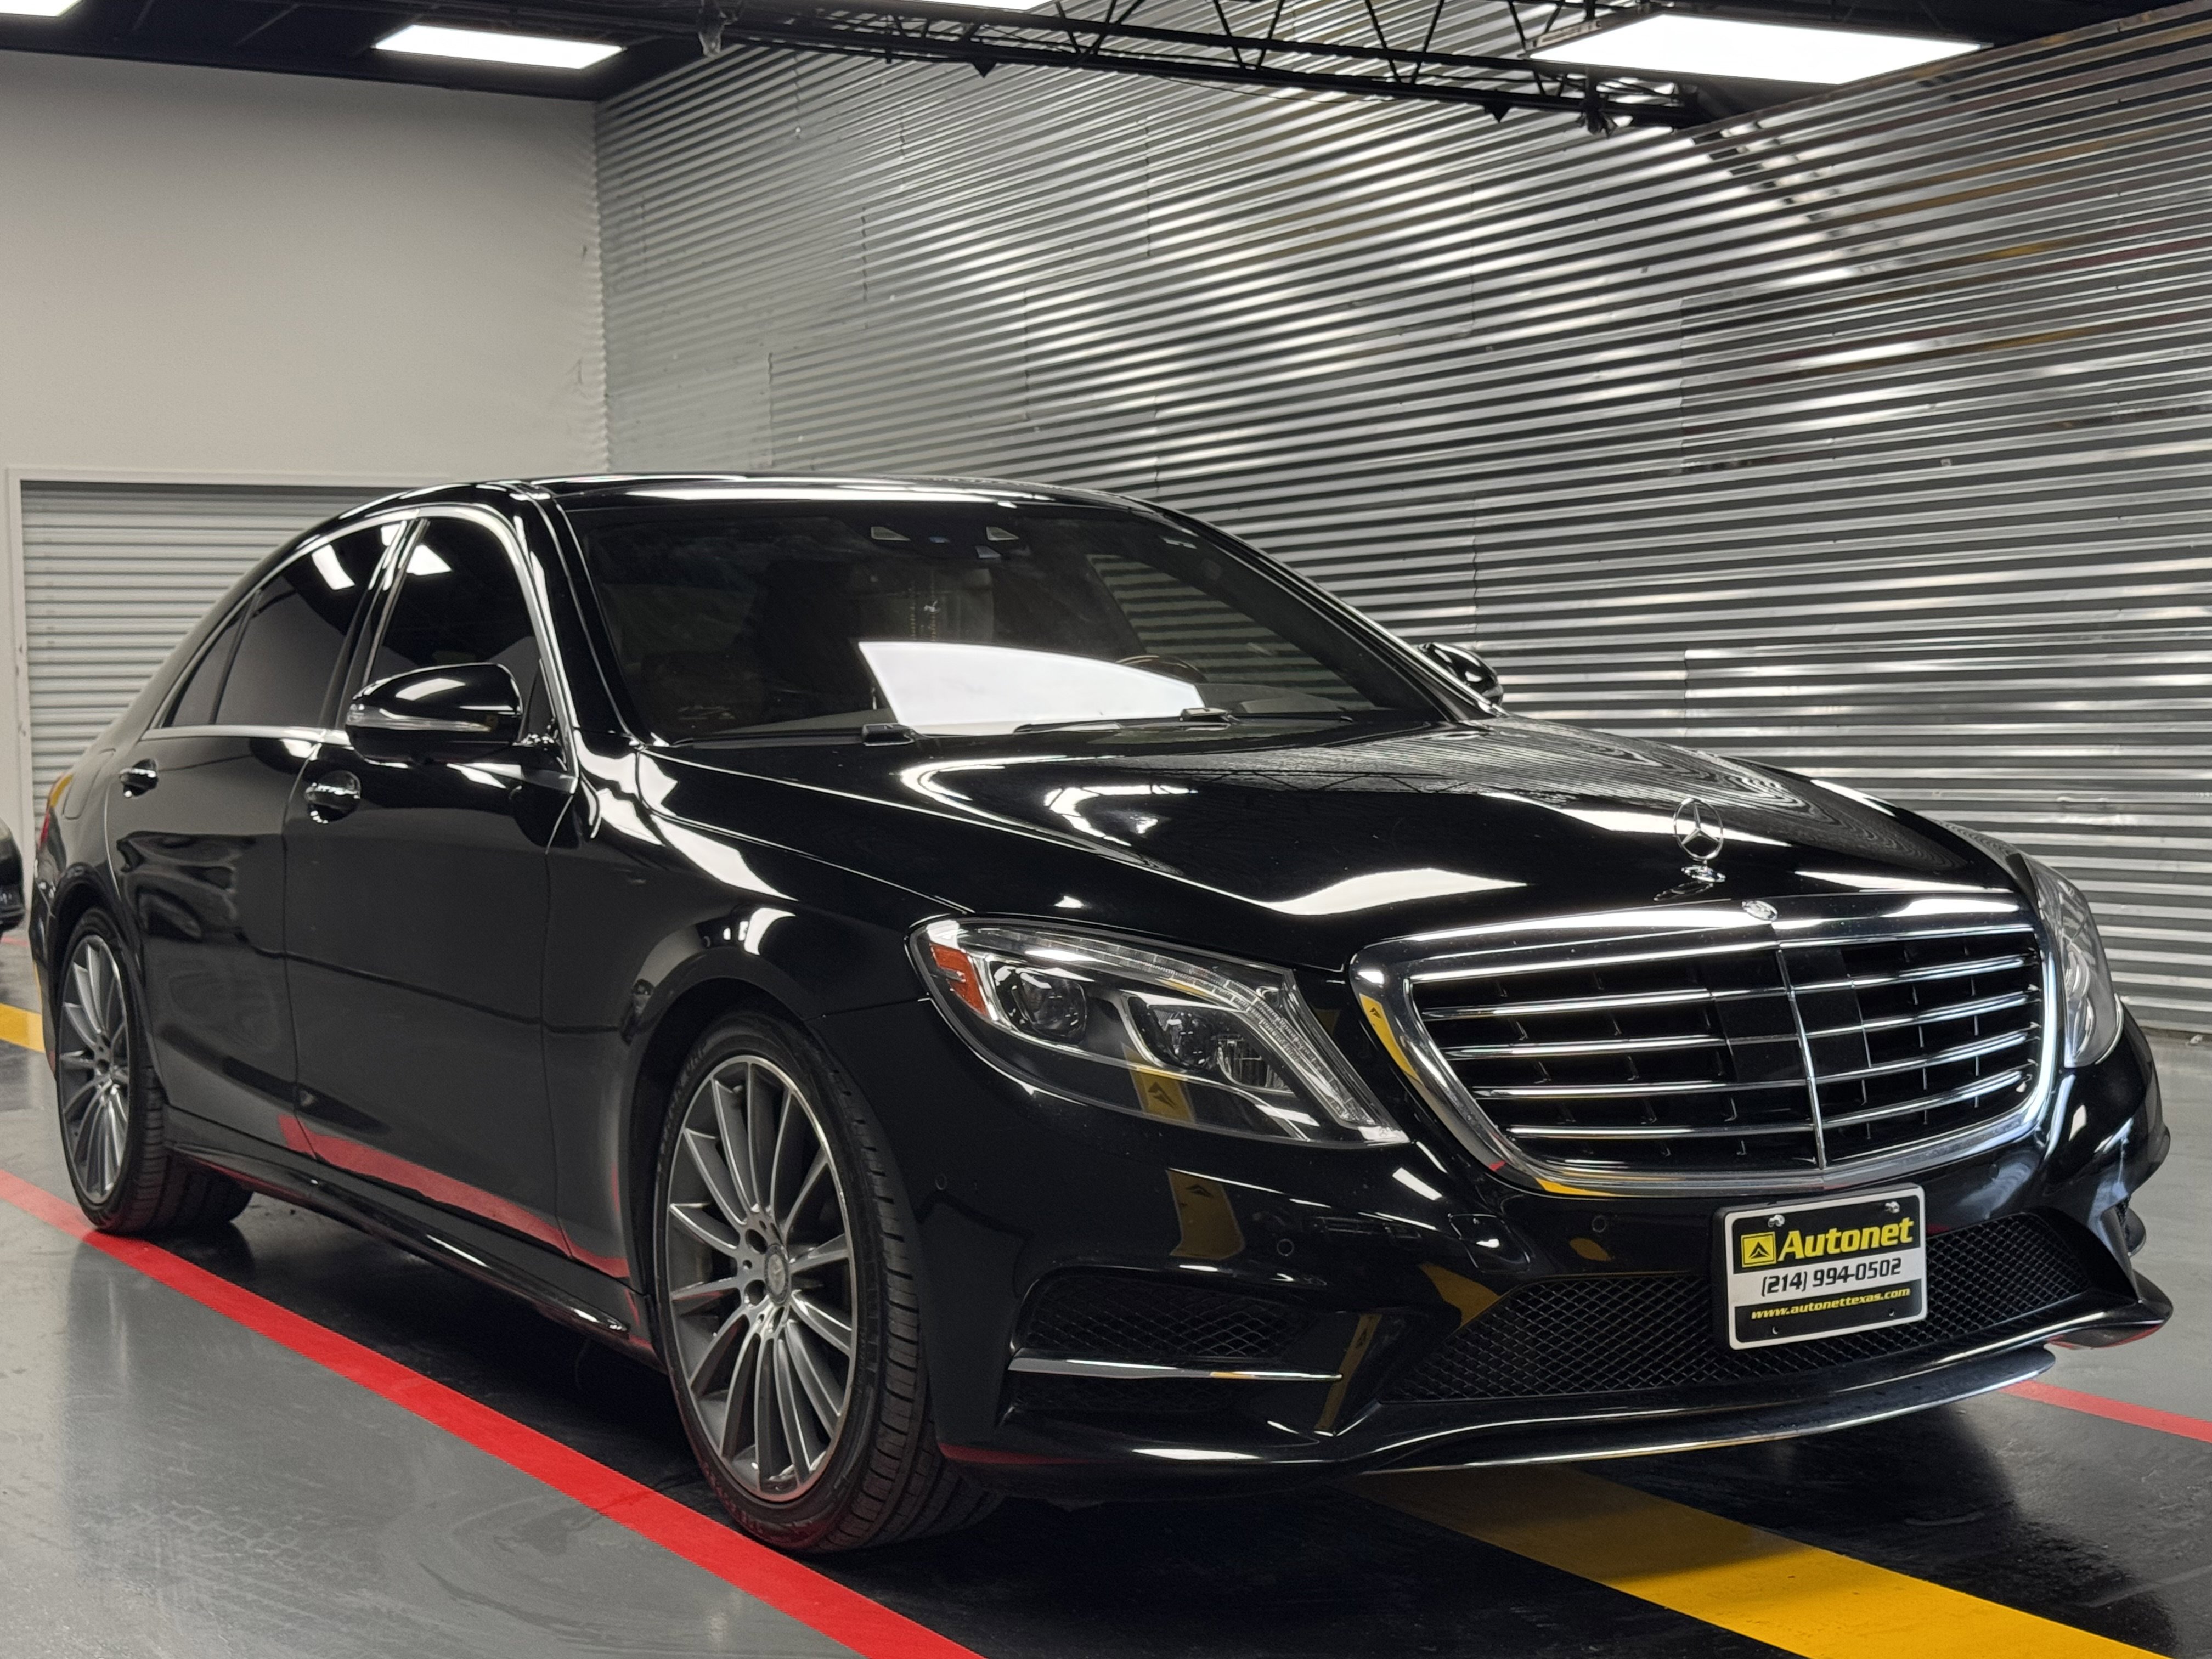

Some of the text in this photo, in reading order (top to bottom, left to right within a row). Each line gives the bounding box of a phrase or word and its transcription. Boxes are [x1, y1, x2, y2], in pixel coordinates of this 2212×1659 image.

[1778, 1217, 1914, 1262] Autonet
[1762, 1257, 1901, 1297] (214) 994-0502
[1751, 1288, 1910, 1319] www.autonettexas.com
